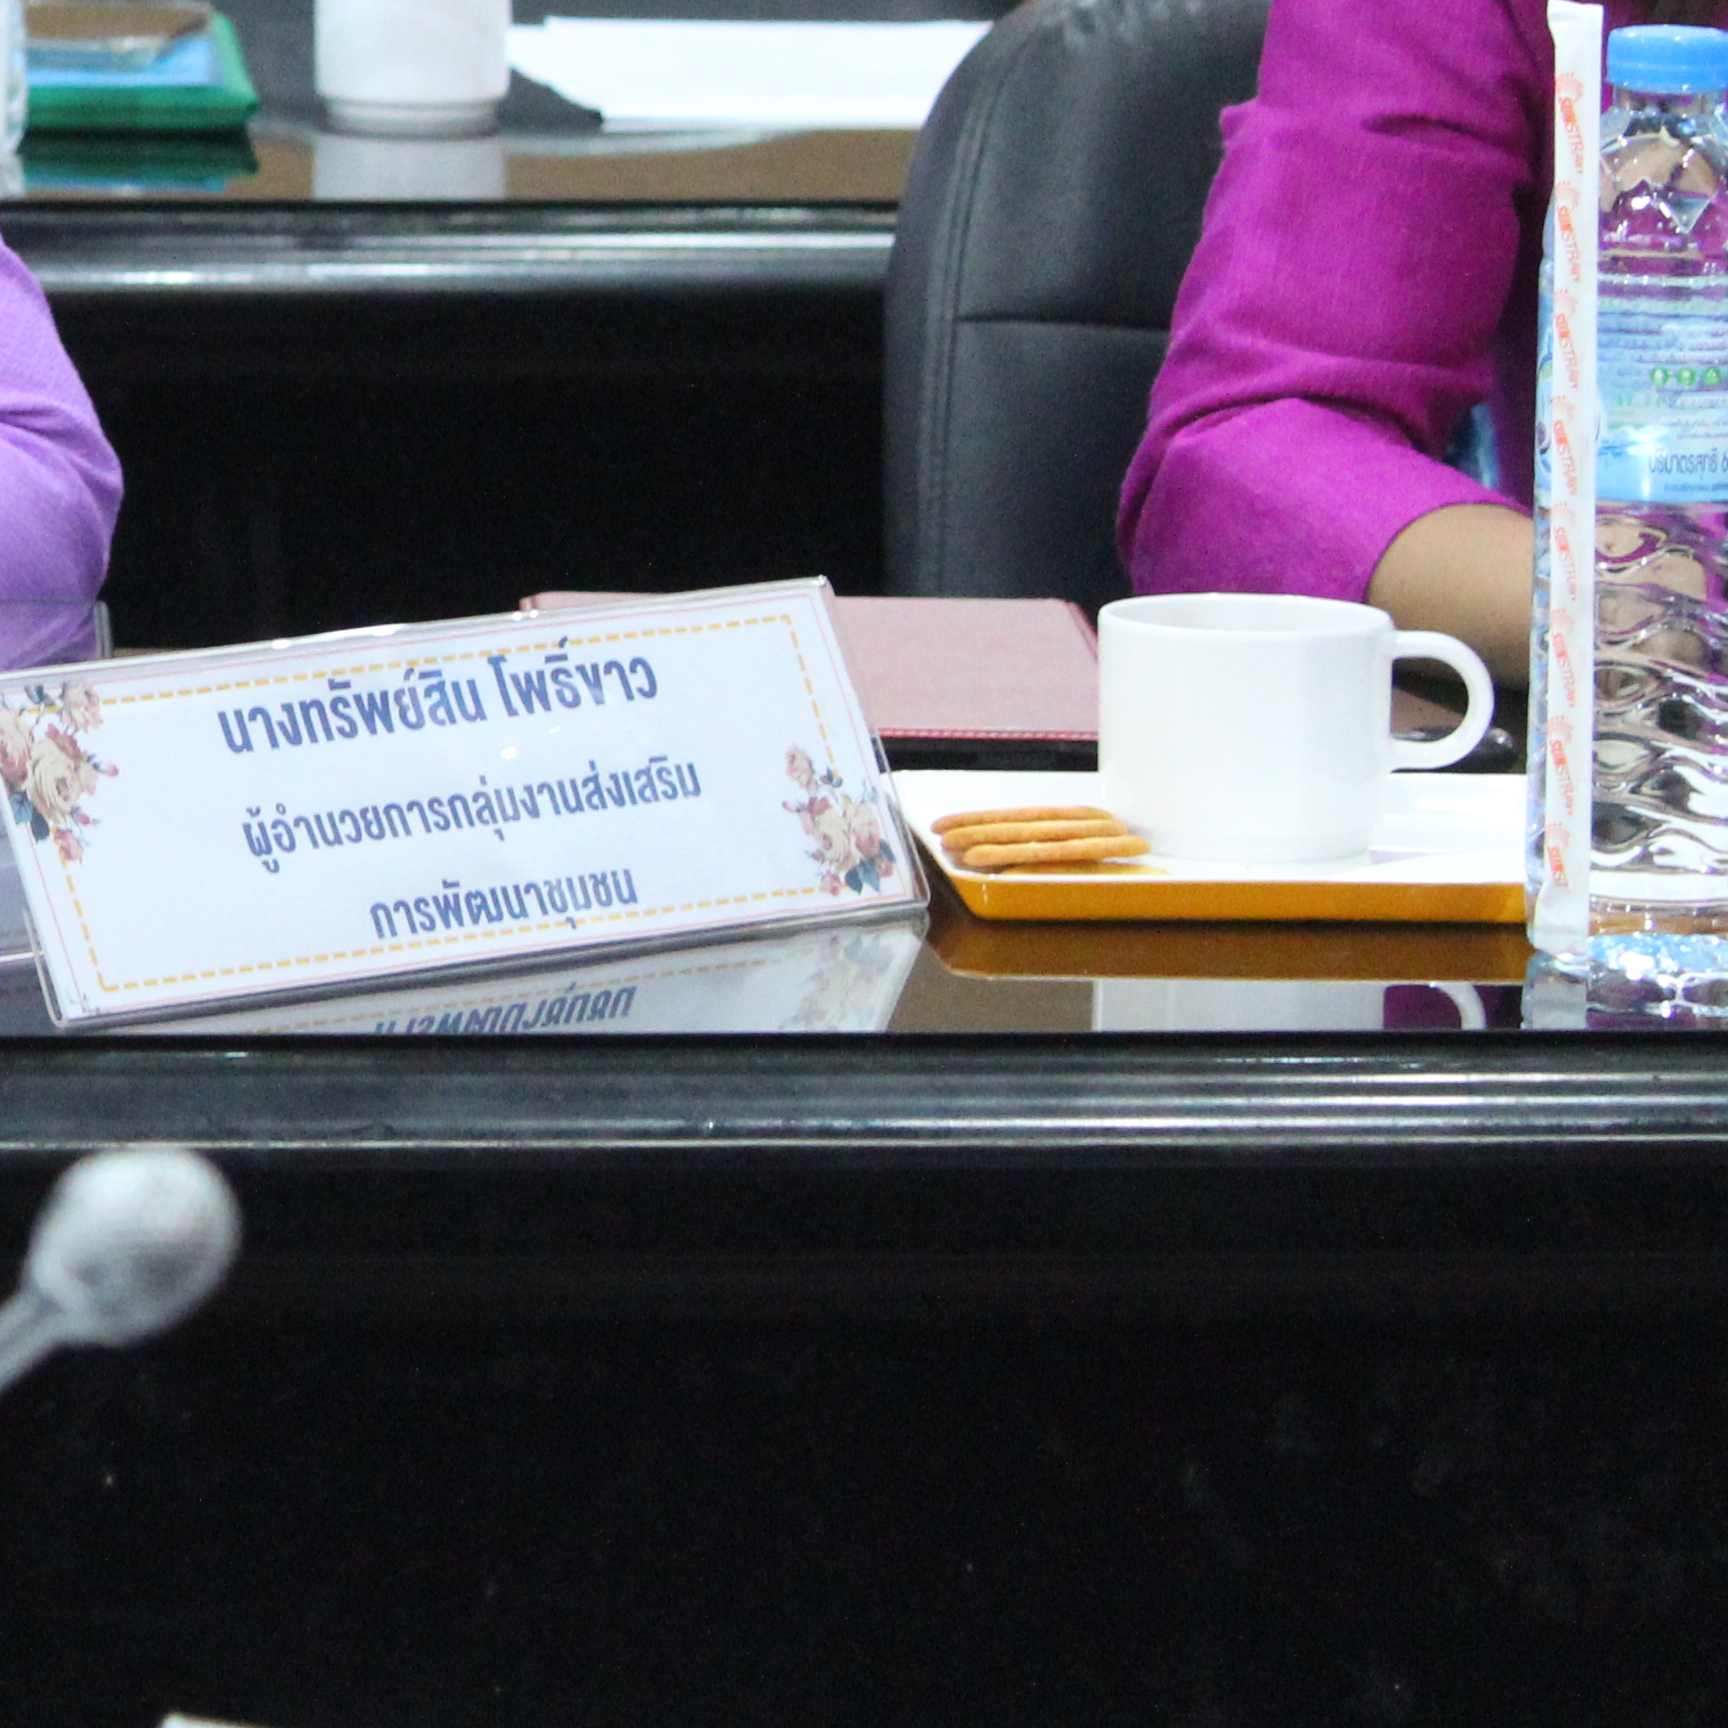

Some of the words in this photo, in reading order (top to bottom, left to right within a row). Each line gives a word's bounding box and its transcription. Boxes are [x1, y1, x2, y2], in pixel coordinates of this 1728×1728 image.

[218, 668, 487, 754] นางทรัพย์สิน
[487, 636, 658, 718] โพธิ์ขาว
[242, 756, 701, 873] ผู้อำนวยการกลุ่มงานส่งเสริม
[369, 869, 639, 939] การพัฒนาชุมชน
